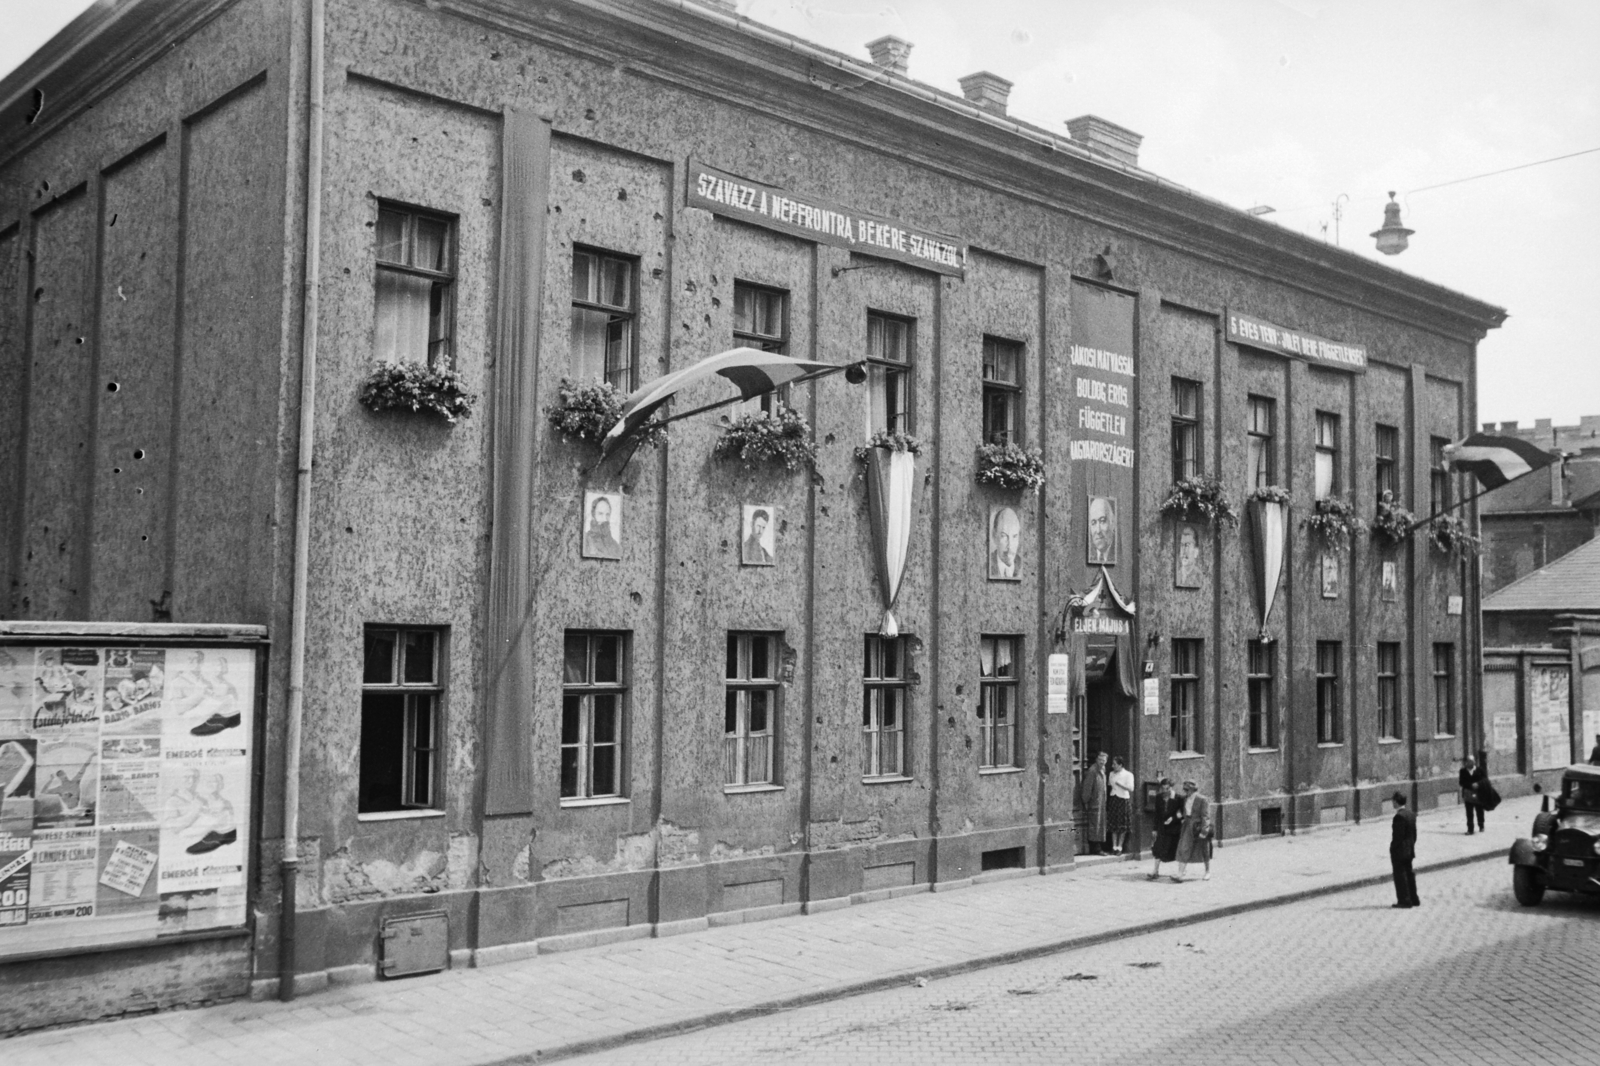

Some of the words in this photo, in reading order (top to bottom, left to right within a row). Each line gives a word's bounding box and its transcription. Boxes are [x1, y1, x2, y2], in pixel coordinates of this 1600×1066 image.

[697, 172, 756, 212] SZAVAZZ
[760, 190, 768, 215] A
[858, 219, 907, 253] BÉKÉRE
[1230, 316, 1237, 335] 5
[1079, 405, 1126, 436] FÜGGETLEN
[1098, 616, 1124, 634] MÁJUS
[165, 748, 203, 760] EMERGÉ
[161, 866, 199, 880] EMERGÉ
[0, 889, 28, 907] 00
[76, 905, 93, 917] 200
